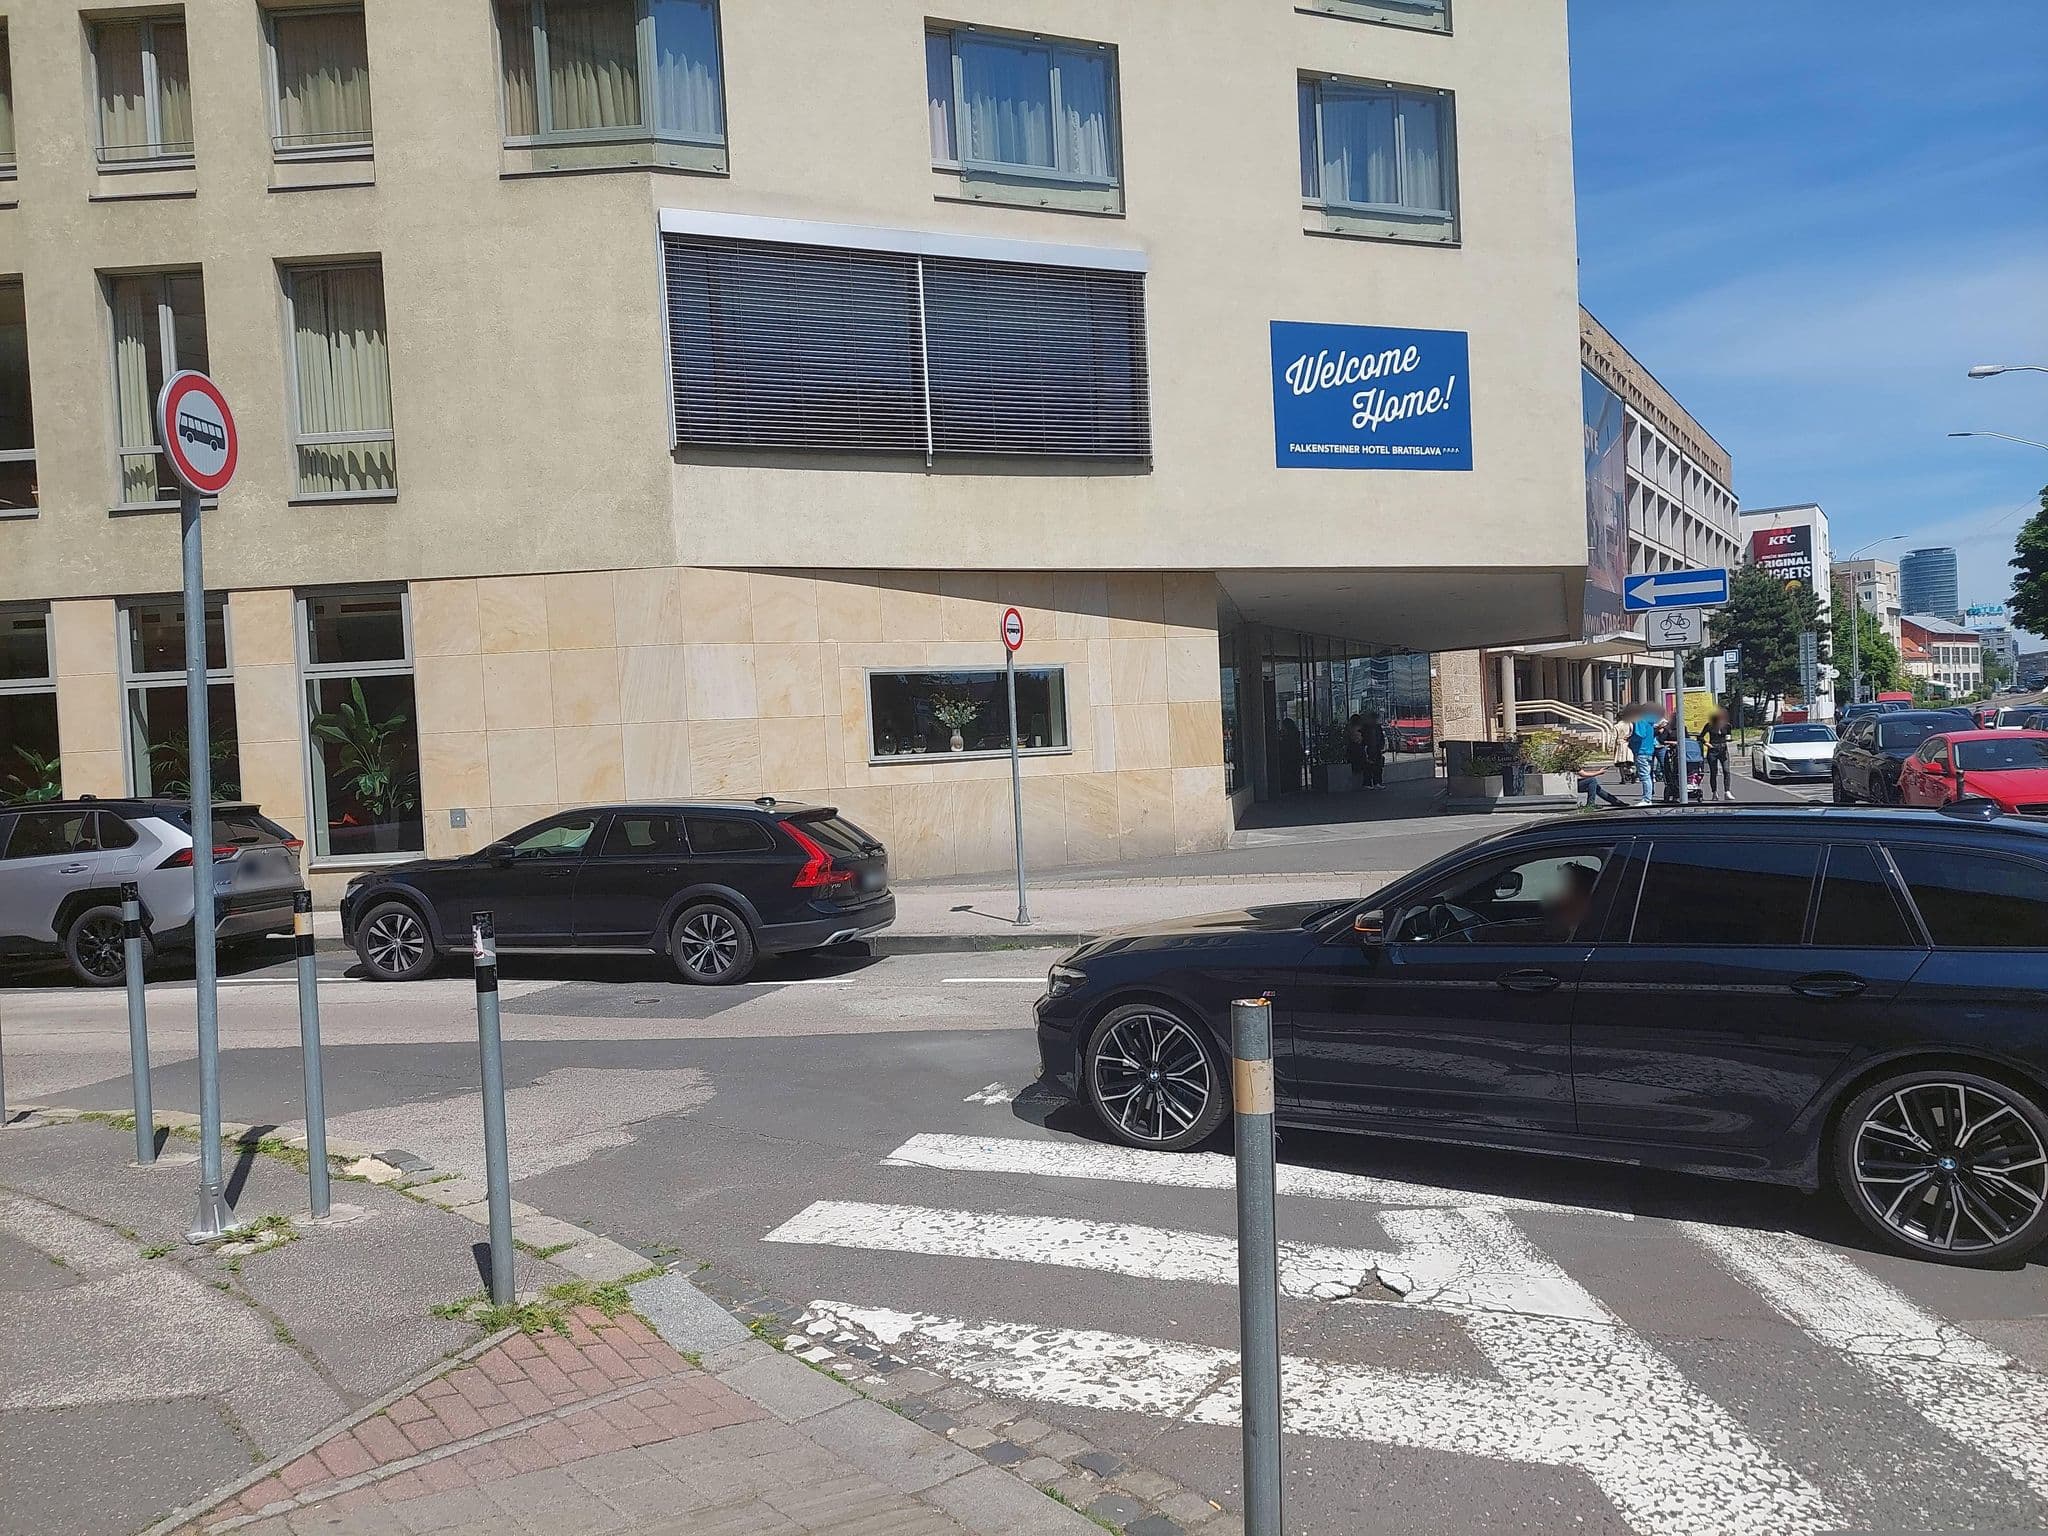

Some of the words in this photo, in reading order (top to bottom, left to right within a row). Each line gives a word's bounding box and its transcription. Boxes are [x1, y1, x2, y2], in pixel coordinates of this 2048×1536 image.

[1286, 345, 1420, 396] Welcome
[1352, 376, 1456, 432] Home!
[1289, 443, 1360, 454] FALKENSTEINER
[1361, 445, 1390, 455] HOTEL
[1392, 446, 1442, 456] BRATISLAVA
[1768, 534, 1797, 546] KFC
